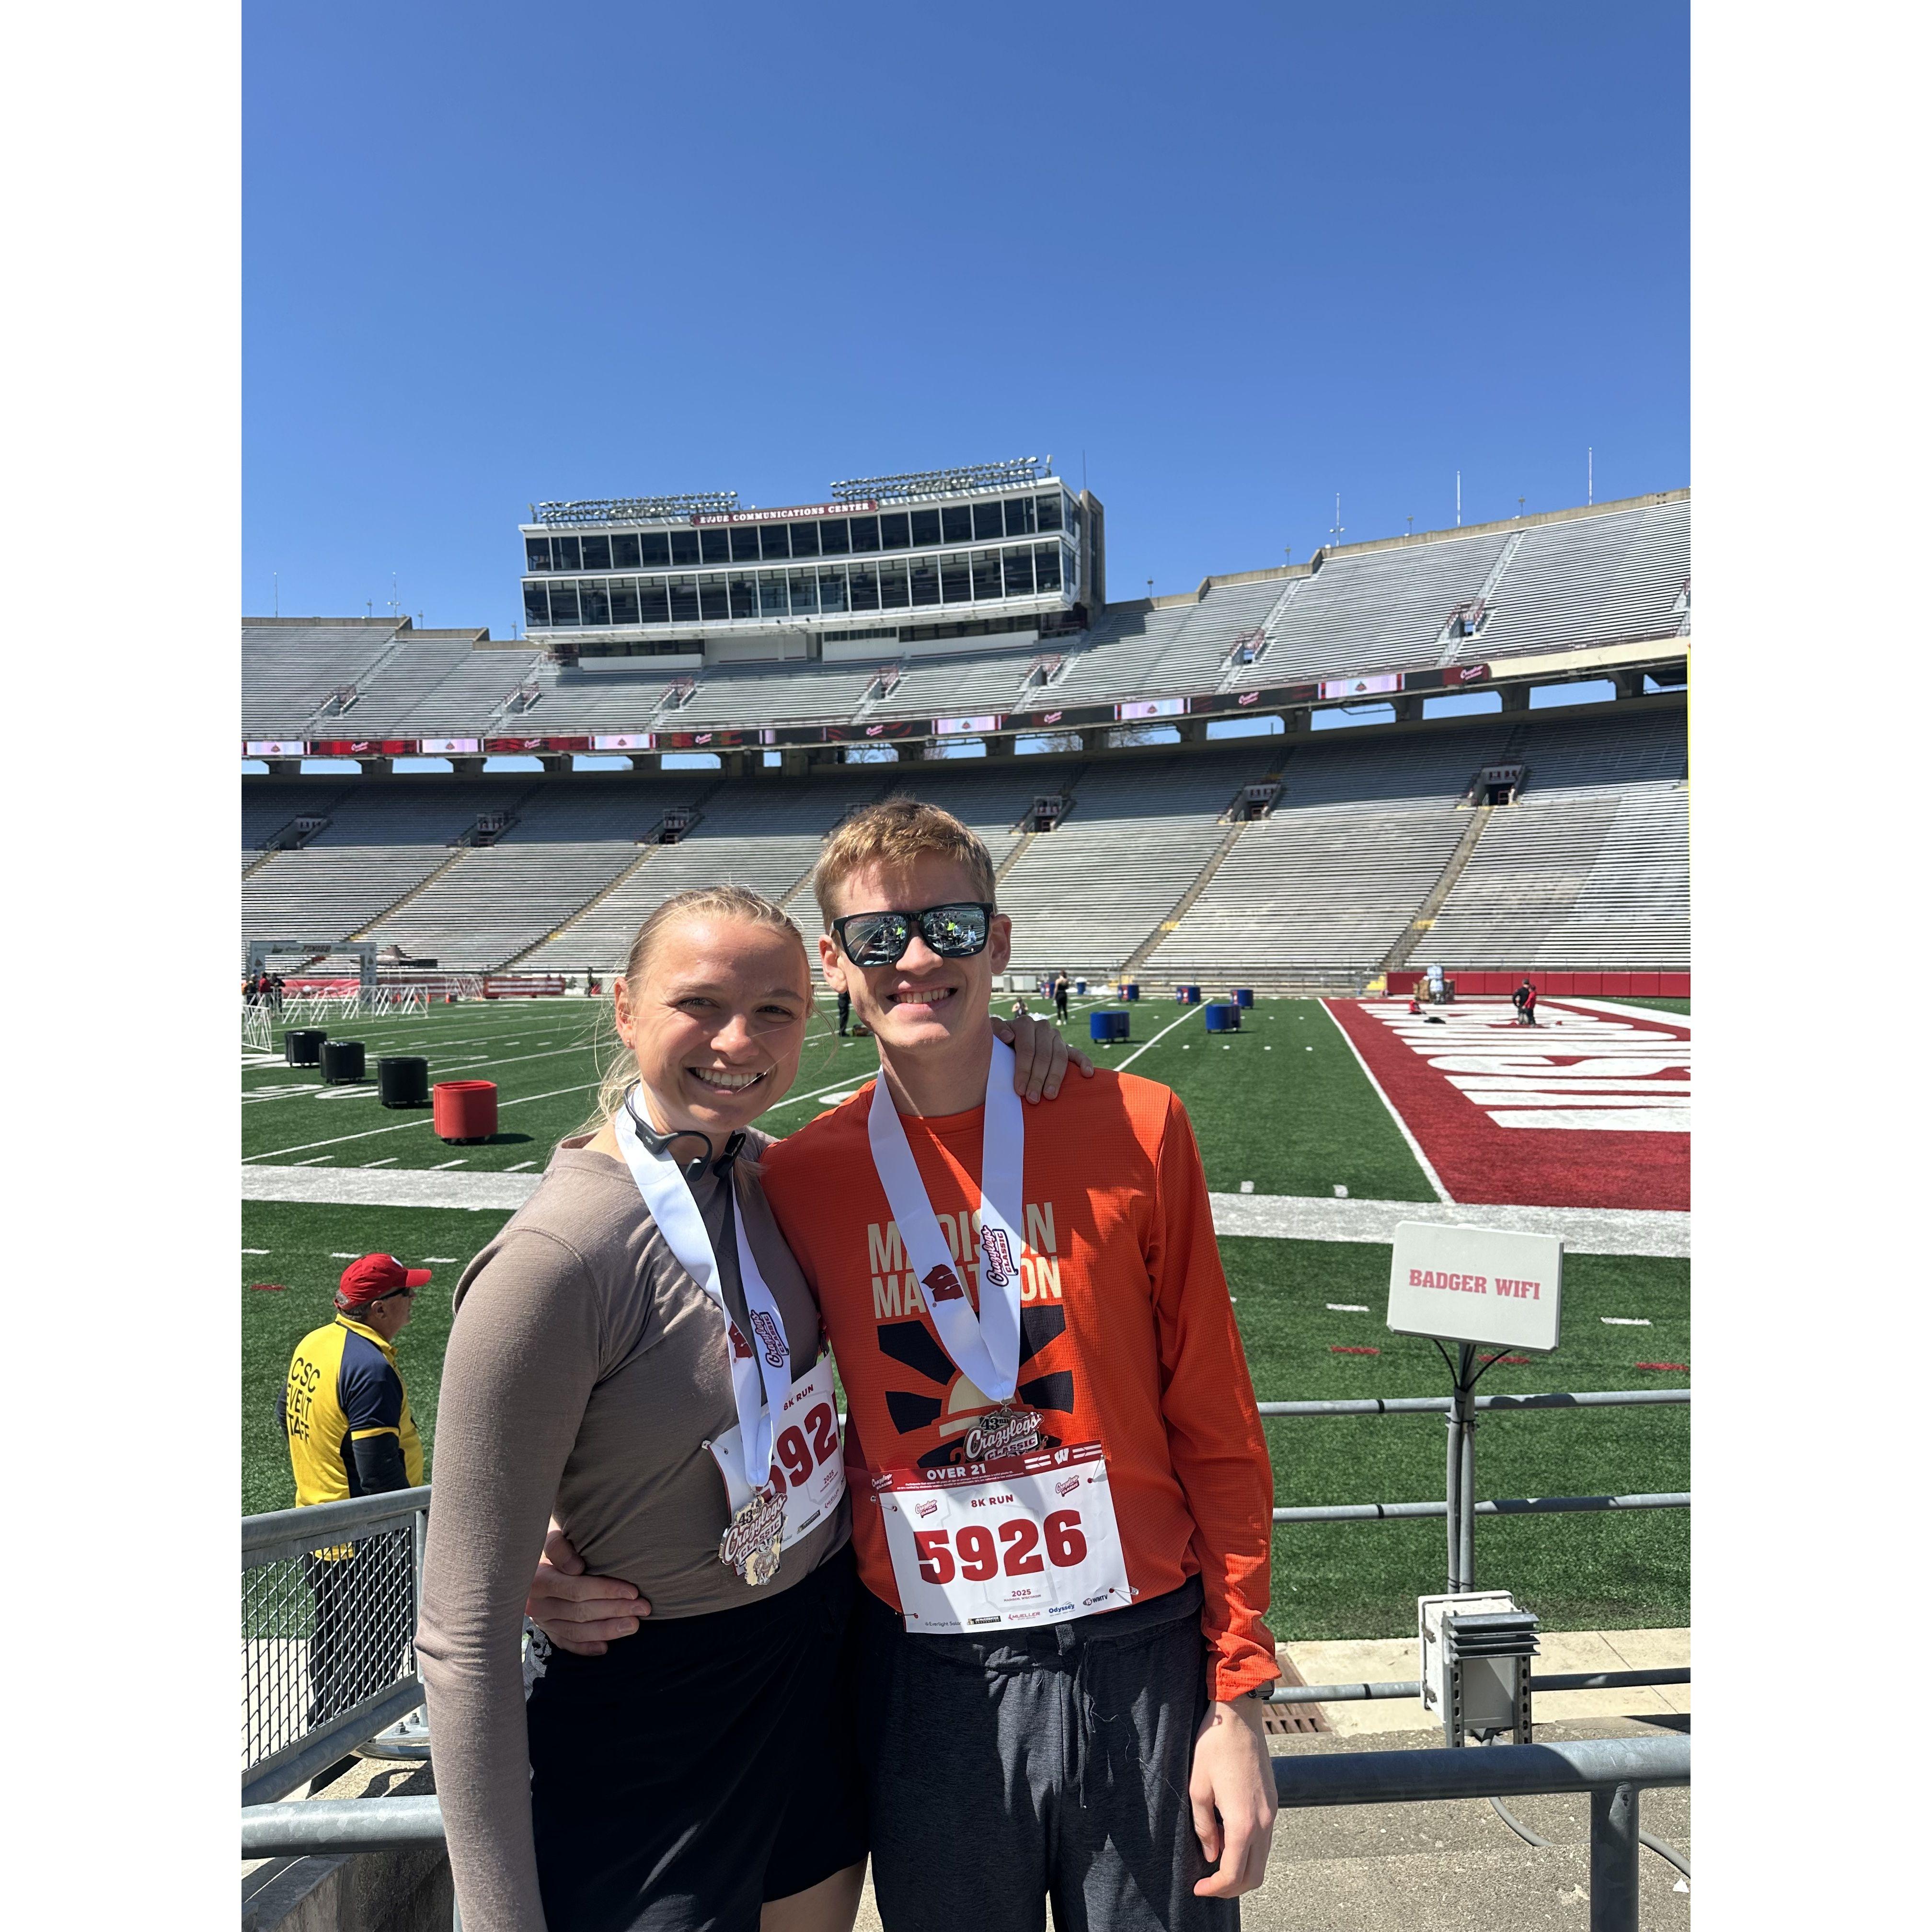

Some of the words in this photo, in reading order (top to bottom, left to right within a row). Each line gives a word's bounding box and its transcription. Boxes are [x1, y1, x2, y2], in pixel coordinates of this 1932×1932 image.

[733, 507, 825, 521] COMMUNICATIONS
[828, 503, 869, 513] CENTER
[981, 1225, 1009, 1287] Crazylegs
[998, 1233, 1012, 1273] CLASSIC
[1409, 1269, 1487, 1294] BADGER
[1495, 1278, 1541, 1300] WIFI
[750, 1310, 783, 1368] Crazylegs
[765, 1316, 784, 1353] CLASSIC
[291, 1357, 321, 1393] CSC
[783, 1400, 794, 1411] 8K
[796, 1384, 814, 1401] RUN
[287, 1412, 310, 1444] TAFF
[965, 1414, 1043, 1459] Crazylegs
[756, 1399, 839, 1503] 592
[988, 1438, 1035, 1460] CLASSIC
[823, 1470, 834, 1484] 2025
[927, 1467, 966, 1480] OVER
[971, 1463, 986, 1475] 21
[1056, 1475, 1079, 1494] Crazylegs
[971, 1499, 986, 1507] 8K
[989, 1494, 1014, 1505] RUN
[1062, 1482, 1079, 1495] CLASSIC
[915, 1499, 937, 1514] Crazylegs
[724, 1495, 787, 1564] Crazylegs
[740, 1520, 780, 1557] CLASSIC
[913, 1509, 1087, 1585] 5926
[1049, 1604, 1075, 1613] Odyssey
[1092, 1594, 1108, 1603] WMTV
